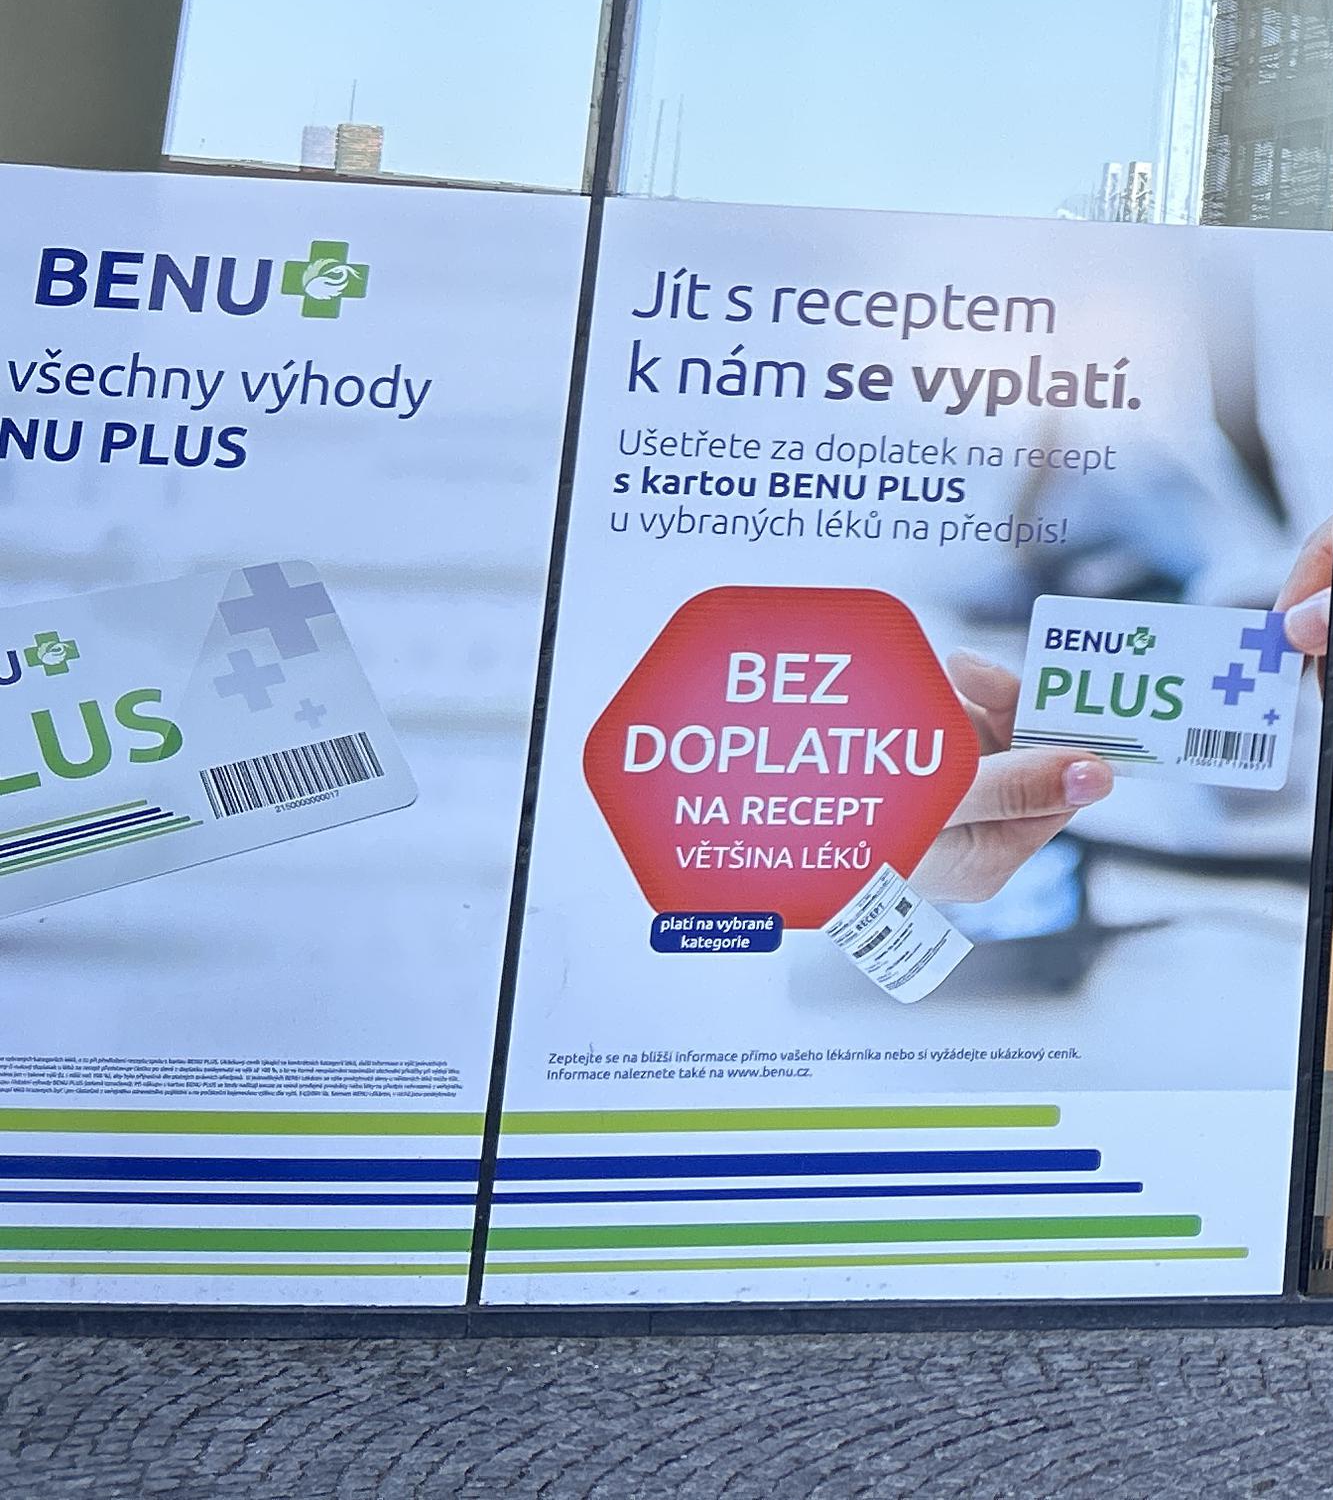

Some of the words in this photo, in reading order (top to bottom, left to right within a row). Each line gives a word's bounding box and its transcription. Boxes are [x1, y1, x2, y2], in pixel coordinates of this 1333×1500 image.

[35, 247, 273, 316] BENU
[631, 268, 711, 323] Jít
[726, 286, 752, 324] s
[771, 282, 1057, 339] receptem
[8, 348, 224, 412] všechny
[242, 359, 432, 419] výhody
[628, 341, 660, 394] k
[679, 345, 806, 399] nám
[823, 361, 893, 402] se
[912, 355, 1141, 418] vyplatí.
[100, 422, 248, 469] PLUS
[618, 428, 761, 461] Ušetřete
[770, 438, 804, 462] za
[815, 434, 958, 469] doplatek
[967, 444, 1005, 467] na
[1014, 442, 1117, 471] recept
[612, 472, 630, 494] s
[641, 468, 756, 498] kartou
[769, 473, 867, 501] BENU
[878, 474, 966, 503] PLUS
[611, 513, 629, 532] u
[640, 505, 804, 542] vybraných
[816, 506, 882, 541] léků
[892, 518, 929, 541] na
[940, 515, 1068, 548] předpis!
[1044, 627, 1124, 654] BENU
[724, 652, 853, 706] BEZ
[1035, 666, 1184, 722] PLUS
[624, 724, 945, 777] DOPLATKU
[675, 798, 729, 826] NA
[741, 798, 883, 827] RECEPT
[676, 841, 794, 870] VĚTŠINA
[801, 840, 872, 870] LÉKŮ
[660, 917, 694, 933] platí
[696, 920, 713, 930] na
[716, 916, 774, 933] vybrané
[681, 935, 750, 951] kategorie
[547, 1068, 611, 1080] Informace
[614, 1068, 676, 1080] naleznete
[679, 1067, 706, 1079] také
[709, 1069, 724, 1079] na
[549, 1052, 602, 1066] Zeptejte
[605, 1054, 620, 1064] se
[623, 1053, 637, 1063] na
[641, 1050, 672, 1063] bližší
[675, 1050, 738, 1063] informace
[741, 1049, 777, 1065] přímo
[780, 1049, 823, 1061] vašeho
[826, 1048, 881, 1061] lékárníka
[885, 1049, 914, 1060] nebo
[930, 1048, 987, 1062] vyžádejte
[990, 1048, 1045, 1062] ukázkový
[1048, 1048, 1081, 1060] ceník.
